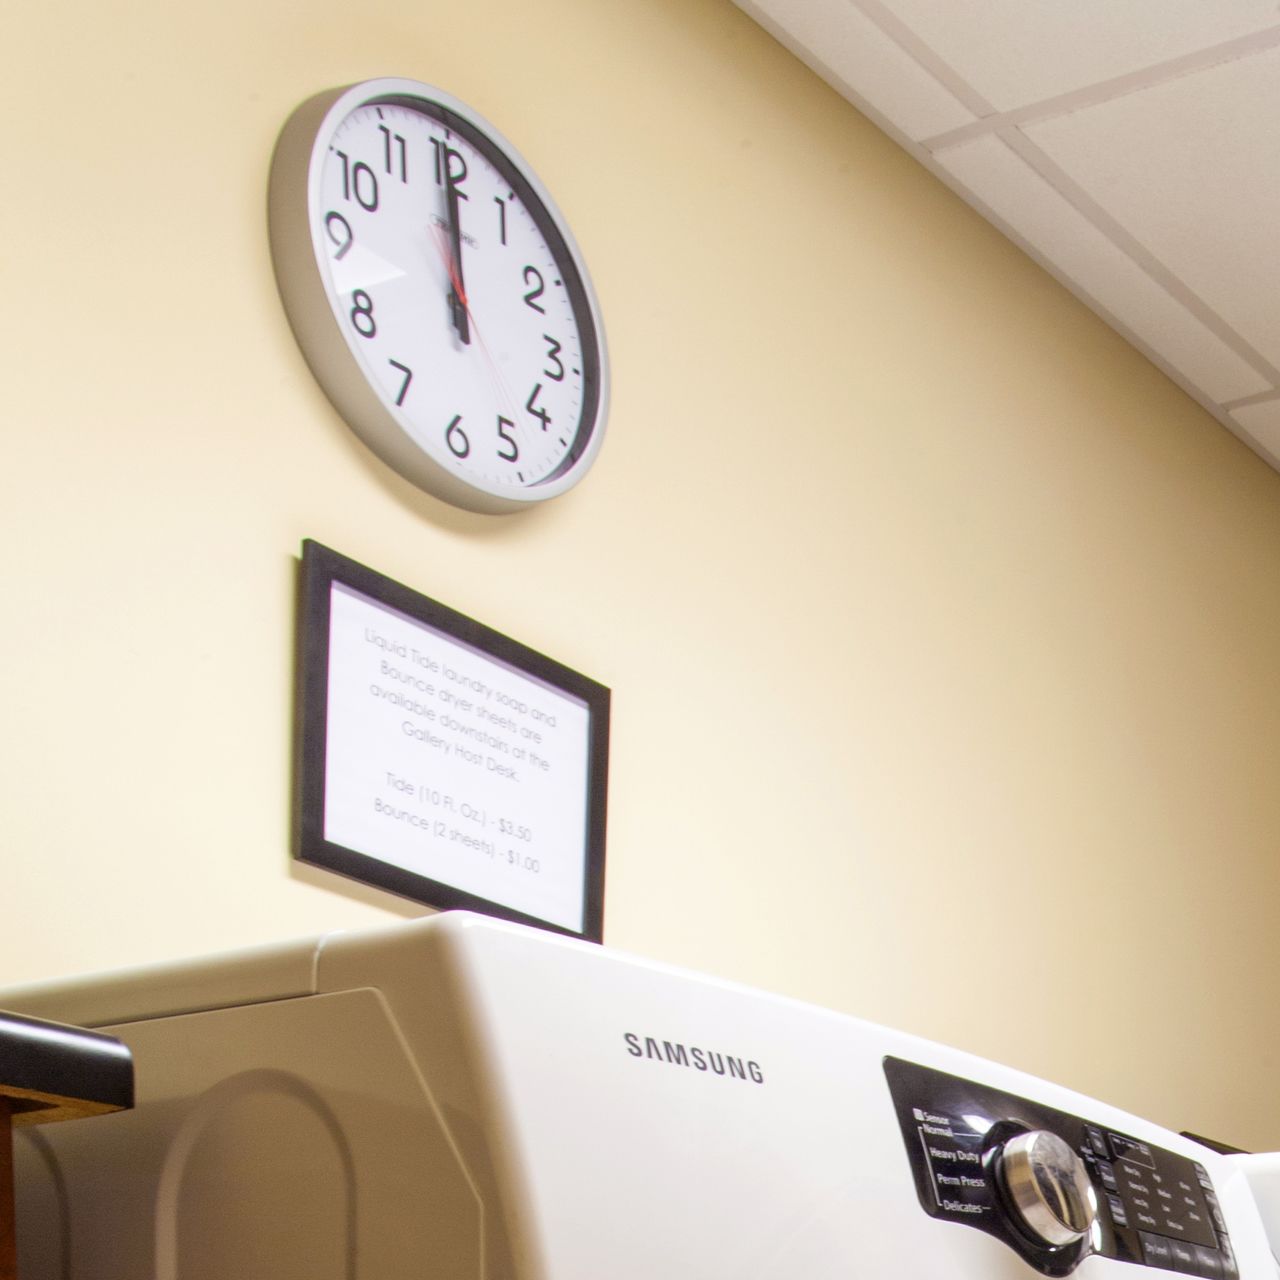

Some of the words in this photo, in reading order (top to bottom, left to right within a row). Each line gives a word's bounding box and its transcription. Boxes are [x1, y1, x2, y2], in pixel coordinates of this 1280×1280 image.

[378, 123, 407, 185] 11
[336, 149, 379, 213] 10
[325, 210, 354, 261] 9
[494, 195, 507, 246] 1
[350, 288, 377, 339] 8
[523, 265, 546, 315] 2
[388, 358, 413, 407] 7
[542, 333, 565, 382] 3
[525, 383, 552, 431] 4
[445, 414, 470, 459] 6
[497, 414, 520, 463] 5
[364, 627, 407, 658] Liquid
[410, 648, 439, 673] Tide
[442, 663, 493, 701] laundry
[495, 691, 528, 716] soap
[530, 708, 557, 728] and
[380, 659, 435, 696] Bounce
[438, 688, 474, 710] dryer
[476, 705, 518, 734] sheets
[520, 727, 543, 745] are
[369, 684, 437, 721] available
[439, 715, 509, 754] downstairs
[512, 747, 527, 761] at
[529, 751, 551, 772] the
[401, 720, 453, 756] Gallery
[455, 743, 484, 766] Host
[386, 771, 415, 796] Tide
[419, 785, 440, 806] (10
[499, 817, 533, 843] $3.50
[374, 797, 430, 831] Bounce
[433, 819, 447, 838] (2
[508, 849, 540, 874] $1.00
[623, 1032, 765, 1084] SAMSUNG
[922, 1123, 954, 1137] Normal
[929, 1146, 957, 1162] Heavy
[956, 1150, 980, 1164] Duty
[936, 1173, 960, 1186] Perm
[960, 1175, 986, 1188] Press
[942, 1199, 983, 1214] Delicates
